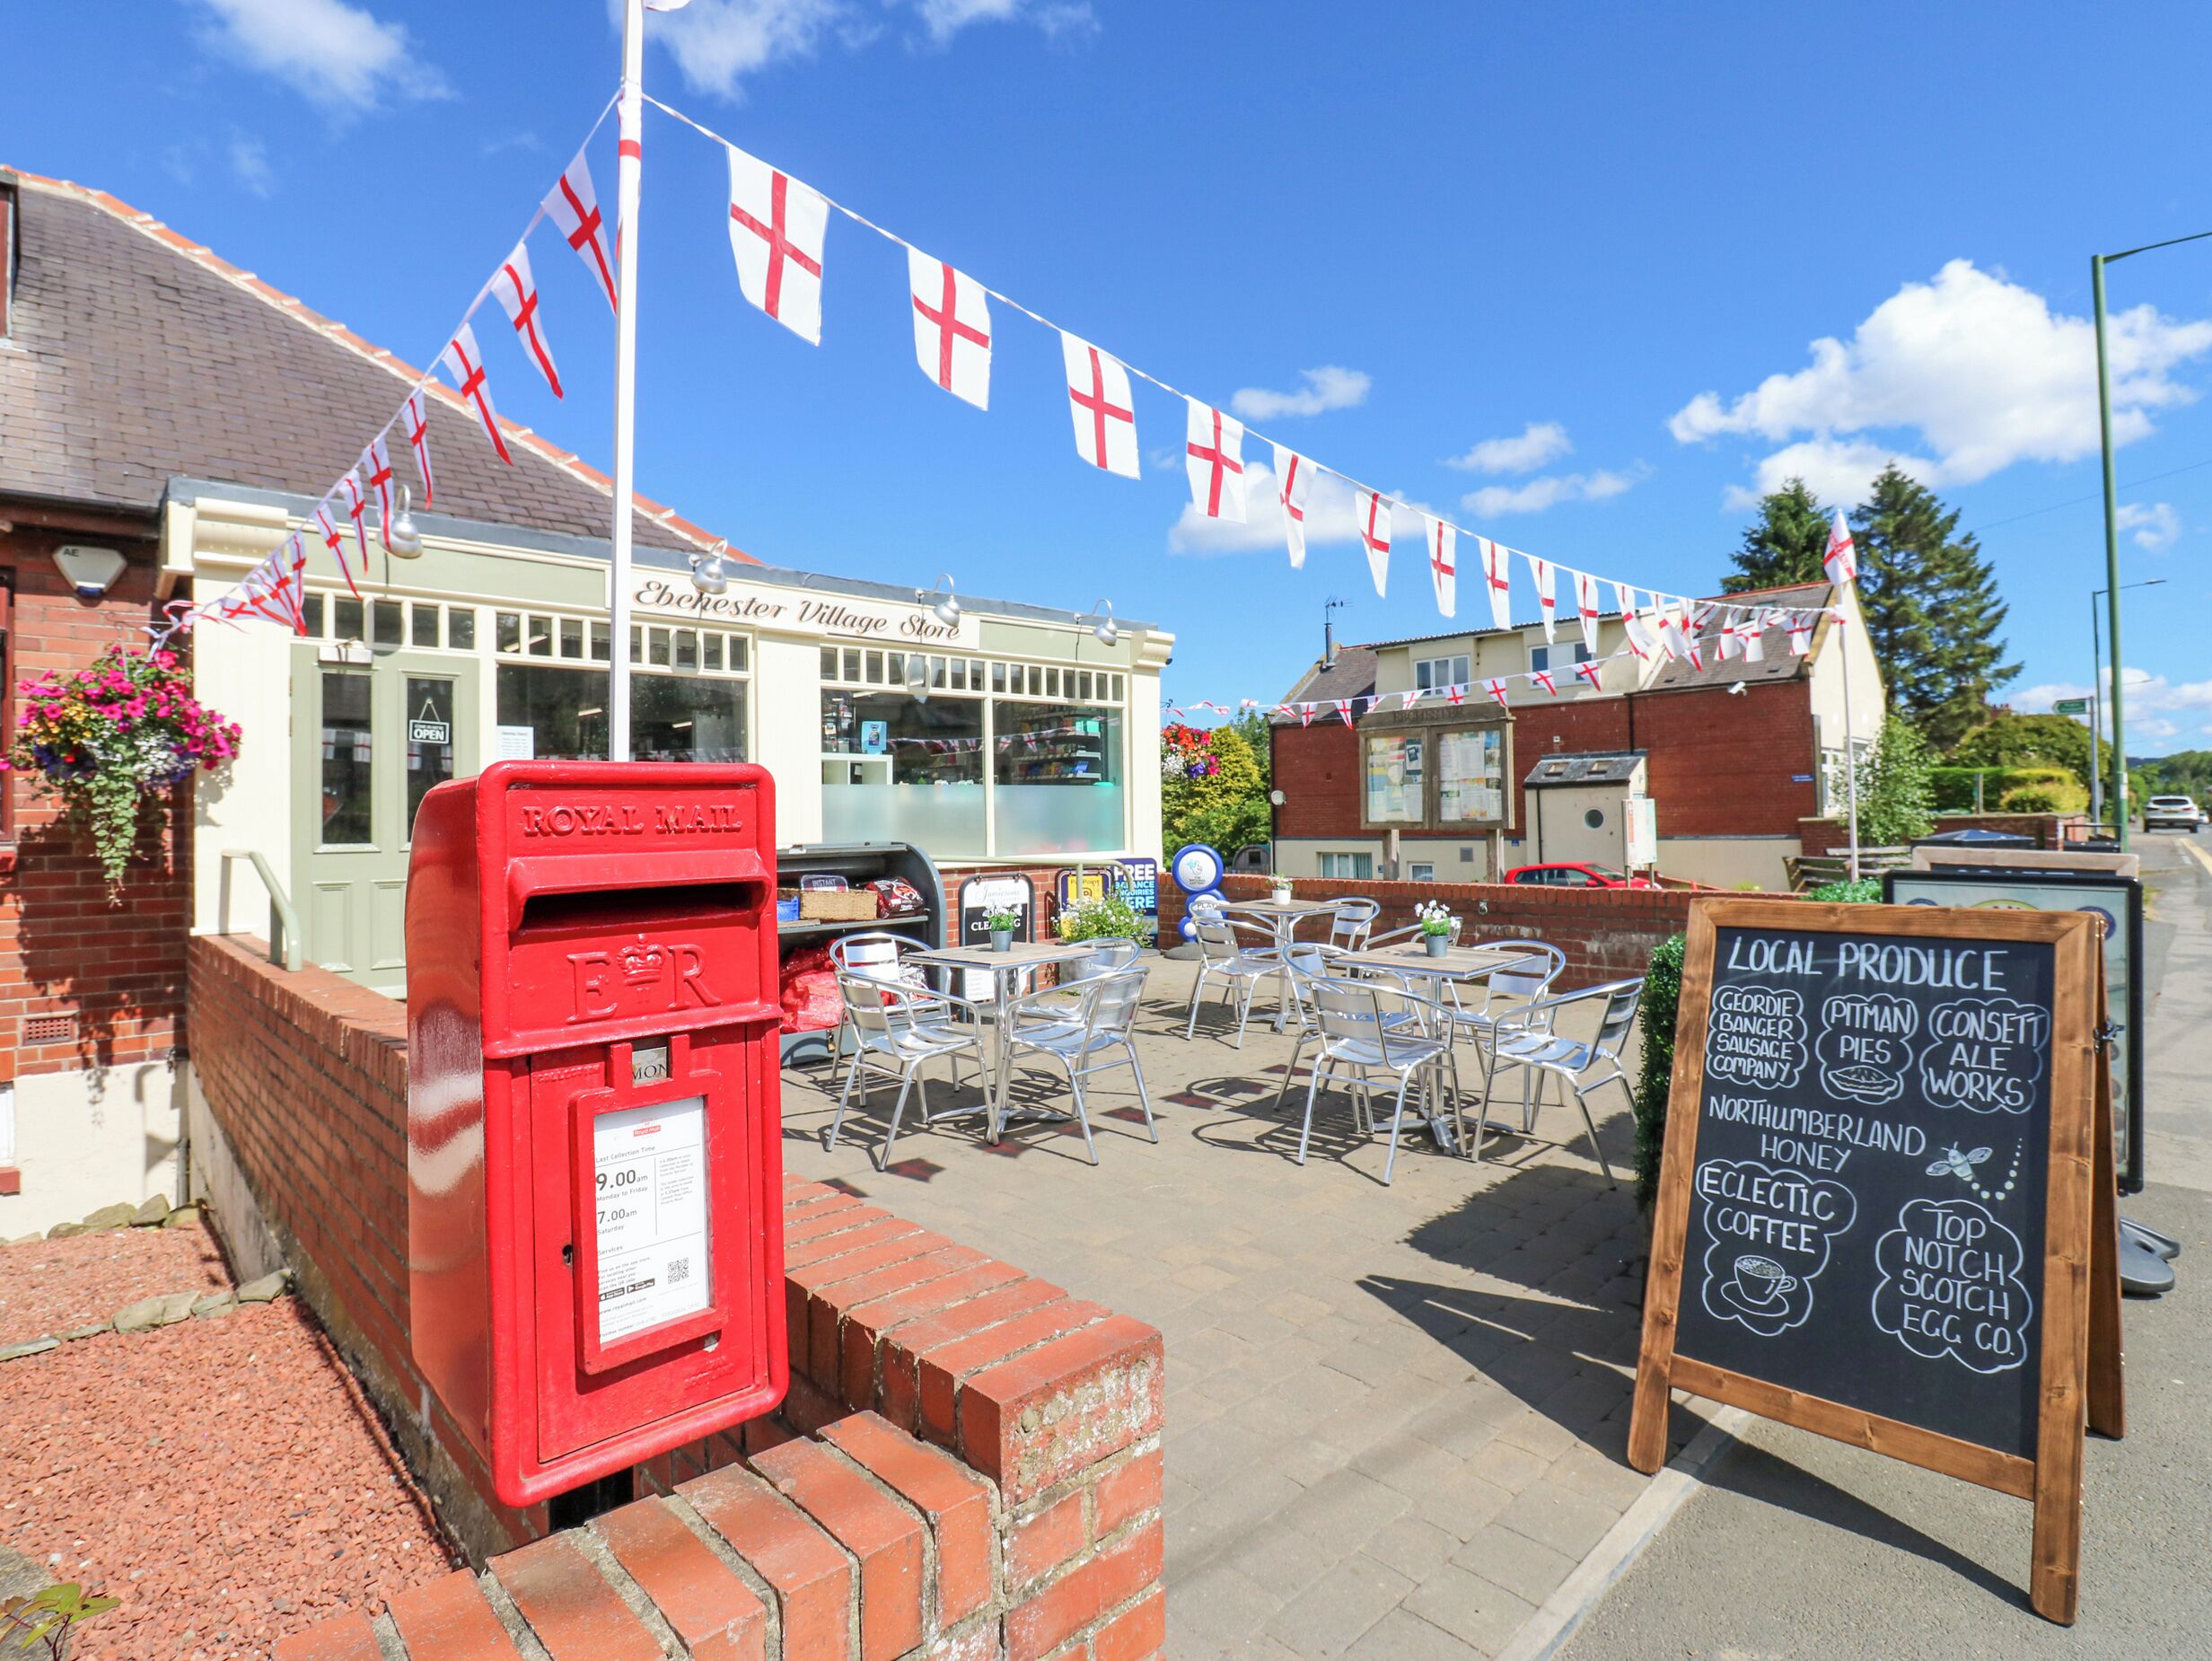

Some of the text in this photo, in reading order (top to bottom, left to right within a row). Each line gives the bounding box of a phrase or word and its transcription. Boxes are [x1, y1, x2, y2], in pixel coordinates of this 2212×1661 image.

[632, 579, 961, 641] Ebchester Village Store
[413, 728, 444, 741] OPEN
[522, 804, 743, 837] ROYAL MAIL
[812, 879, 836, 887] INSTANT
[1114, 864, 1154, 881] FREE
[1120, 896, 1155, 909] ERE
[1727, 936, 2008, 992] LOCAL PRODUCE
[566, 944, 723, 1024] E R
[1719, 992, 1795, 1018] GEORDIE
[1830, 1000, 1911, 1034] PITMAN
[1718, 1014, 1795, 1040] BANGER
[1936, 1009, 2045, 1048] CONSETT
[1716, 1035, 1795, 1060] SAUSAGE
[1839, 1035, 1892, 1065] PIES
[1950, 1043, 2012, 1072] ALE
[1713, 1055, 1790, 1082] COMPANY
[1927, 1067, 2024, 1108] WORKS
[1709, 1094, 1927, 1156] NORTHUMBERLAND
[610, 1149, 640, 1160] Collection
[1760, 1134, 1851, 1173] HONEY
[596, 1191, 619, 1202] Monday
[629, 1186, 648, 1195] Friday
[1702, 1166, 1835, 1221] ECLECTIC
[597, 1225, 624, 1235] Saturday
[1717, 1208, 1818, 1254] COFFEE
[1922, 1208, 1987, 1246] TOP
[598, 1245, 623, 1255] Services
[1905, 1235, 2005, 1287] NOTCH
[1899, 1269, 2010, 1321] SCOTCH
[1903, 1303, 1962, 1344] EGG
